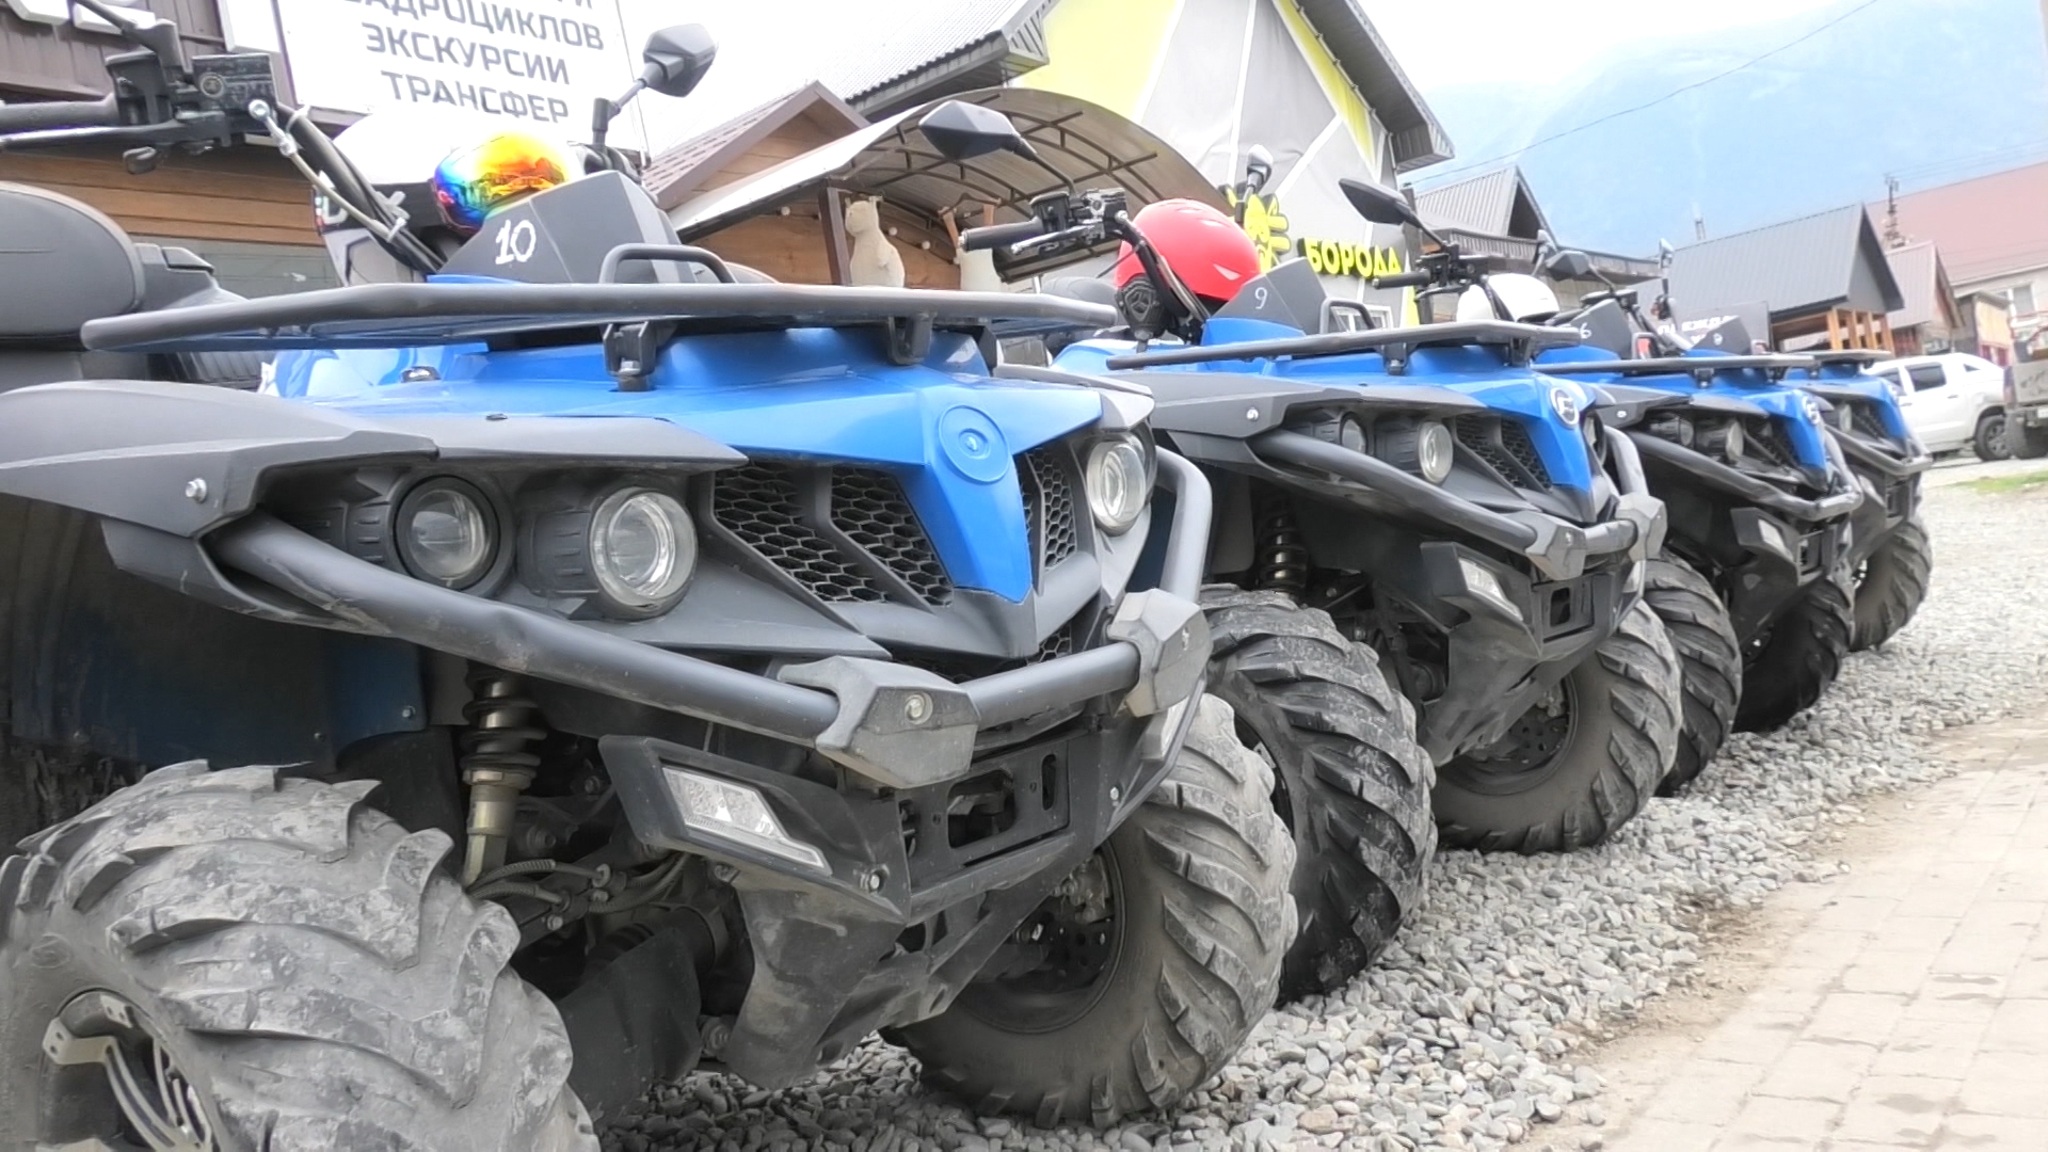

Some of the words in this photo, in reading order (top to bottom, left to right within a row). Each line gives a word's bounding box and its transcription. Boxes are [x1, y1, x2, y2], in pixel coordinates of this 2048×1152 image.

[361, 22, 570, 85] ЭКСКУРСИИ
[380, 70, 569, 123] ТРАНСФЕР
[495, 219, 537, 265] 10
[1254, 286, 1268, 310] 9
[1579, 322, 1592, 339] 6
